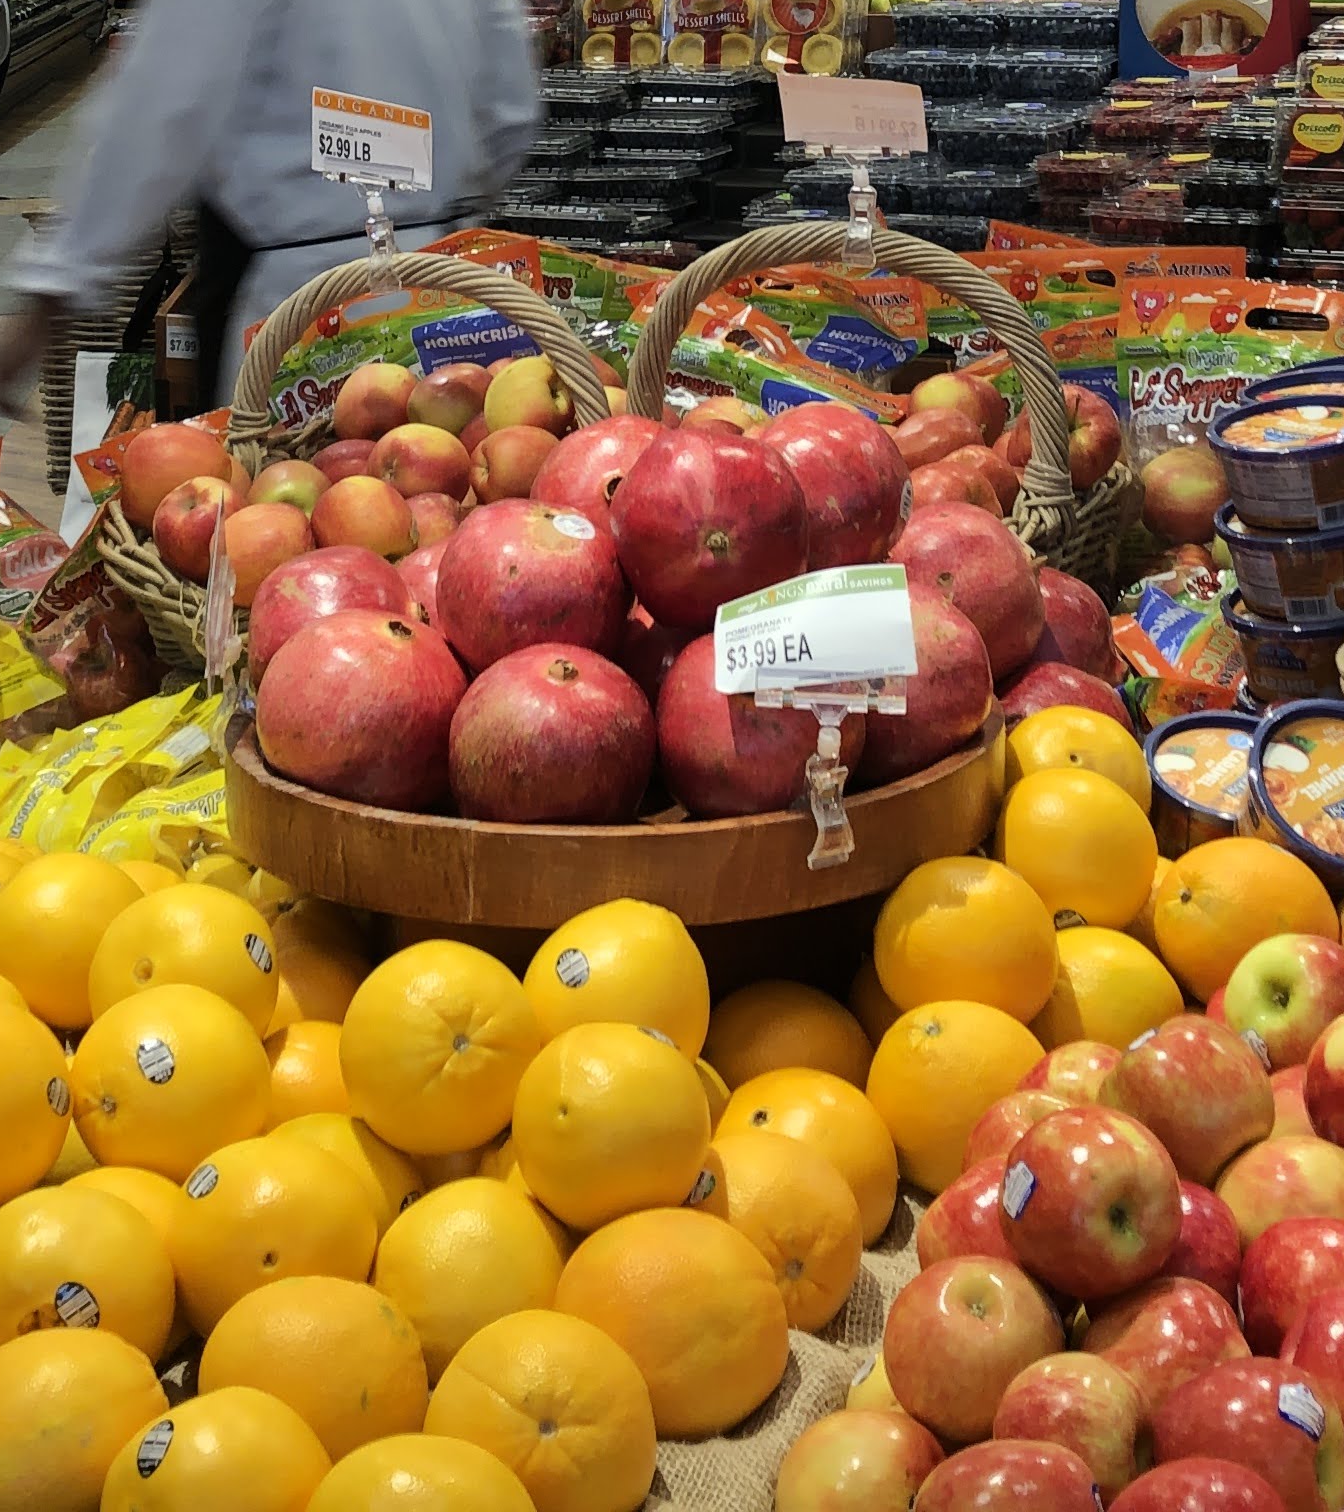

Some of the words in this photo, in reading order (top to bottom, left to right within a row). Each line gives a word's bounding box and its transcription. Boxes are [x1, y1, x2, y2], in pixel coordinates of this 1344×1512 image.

[592, 9, 624, 24] DESSERT
[625, 7, 652, 21] SHELLS
[678, 13, 714, 28] DESSERT
[715, 11, 746, 25] SHELLS
[319, 93, 424, 127] ORGANIC
[1296, 122, 1341, 134] Driscoll's
[319, 133, 351, 160] $2.99
[354, 140, 371, 162] LB
[1167, 262, 1232, 277] ARTISAN
[1188, 346, 1239, 371] Organic
[849, 577, 894, 589] SAVINGS
[725, 615, 793, 639] POMEGRANATE
[726, 637, 777, 675] $3.99
[783, 632, 813, 664] EA
[1195, 748, 1247, 788] CARAMEL
